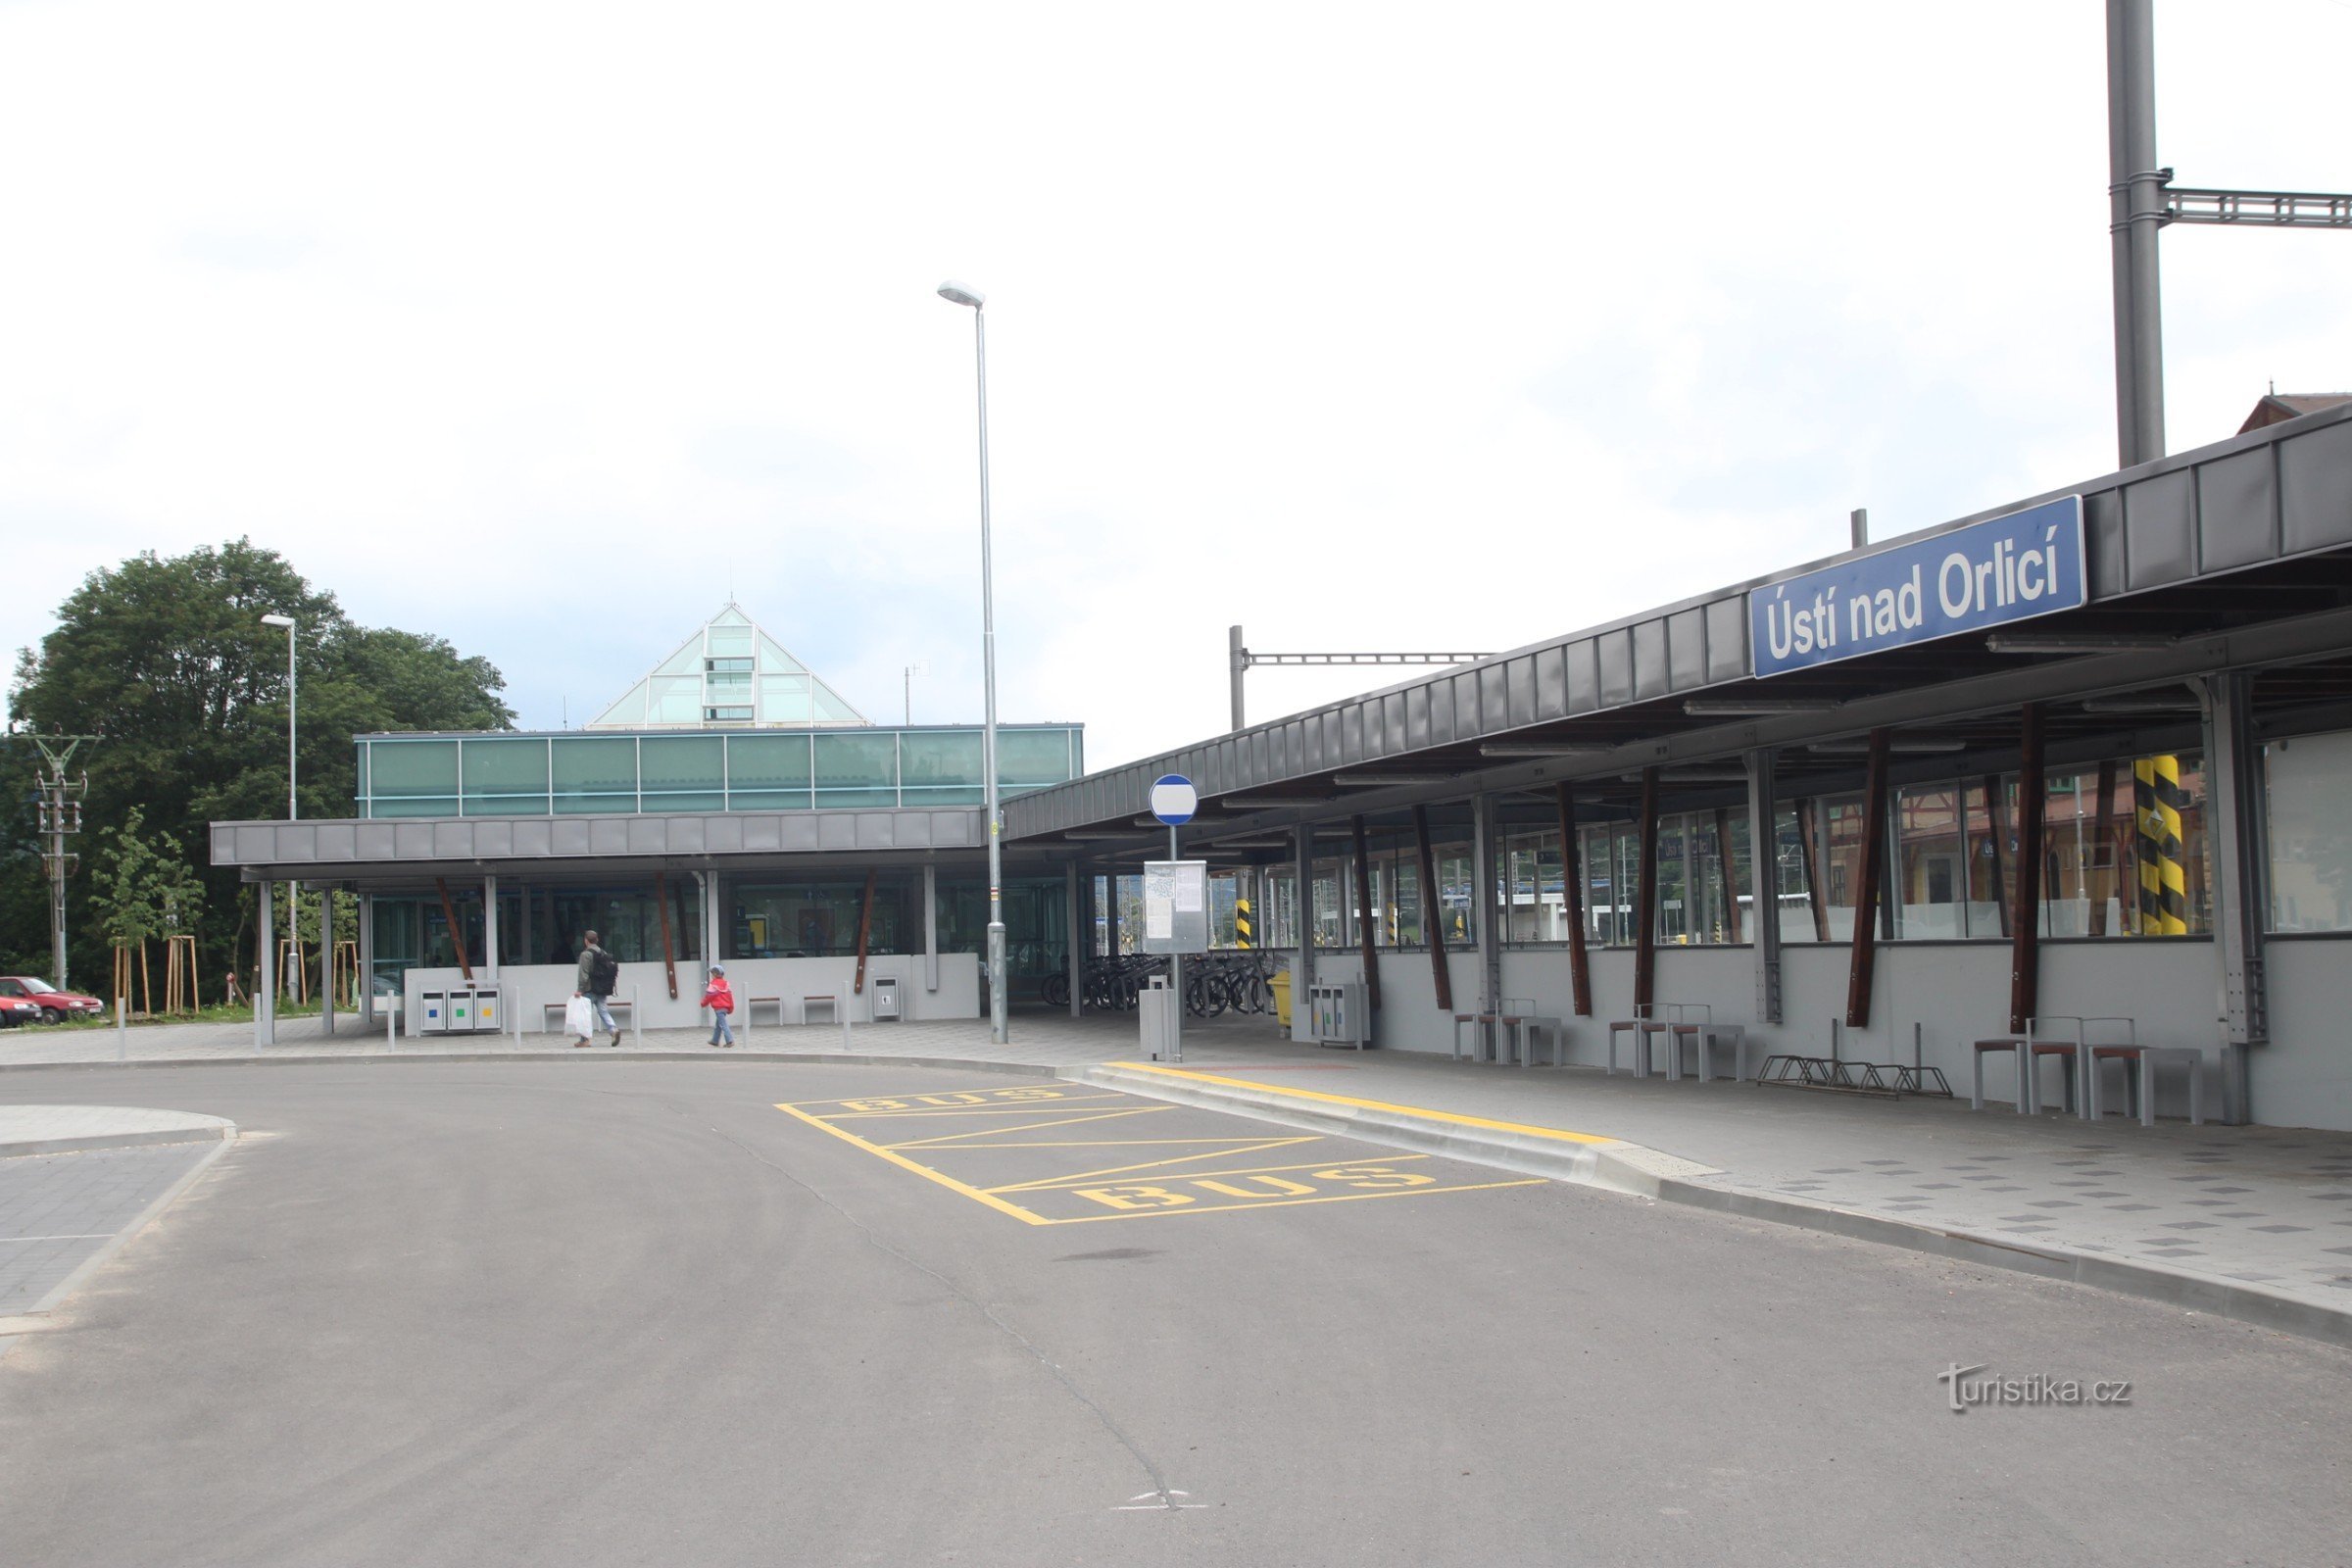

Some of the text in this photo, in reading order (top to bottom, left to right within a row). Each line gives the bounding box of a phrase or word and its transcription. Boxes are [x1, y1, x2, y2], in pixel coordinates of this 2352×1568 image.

[1768, 525, 2059, 661] Ústí nad Orlicí
[840, 1089, 1064, 1112] BUS
[1072, 1167, 1438, 1210] BUS
